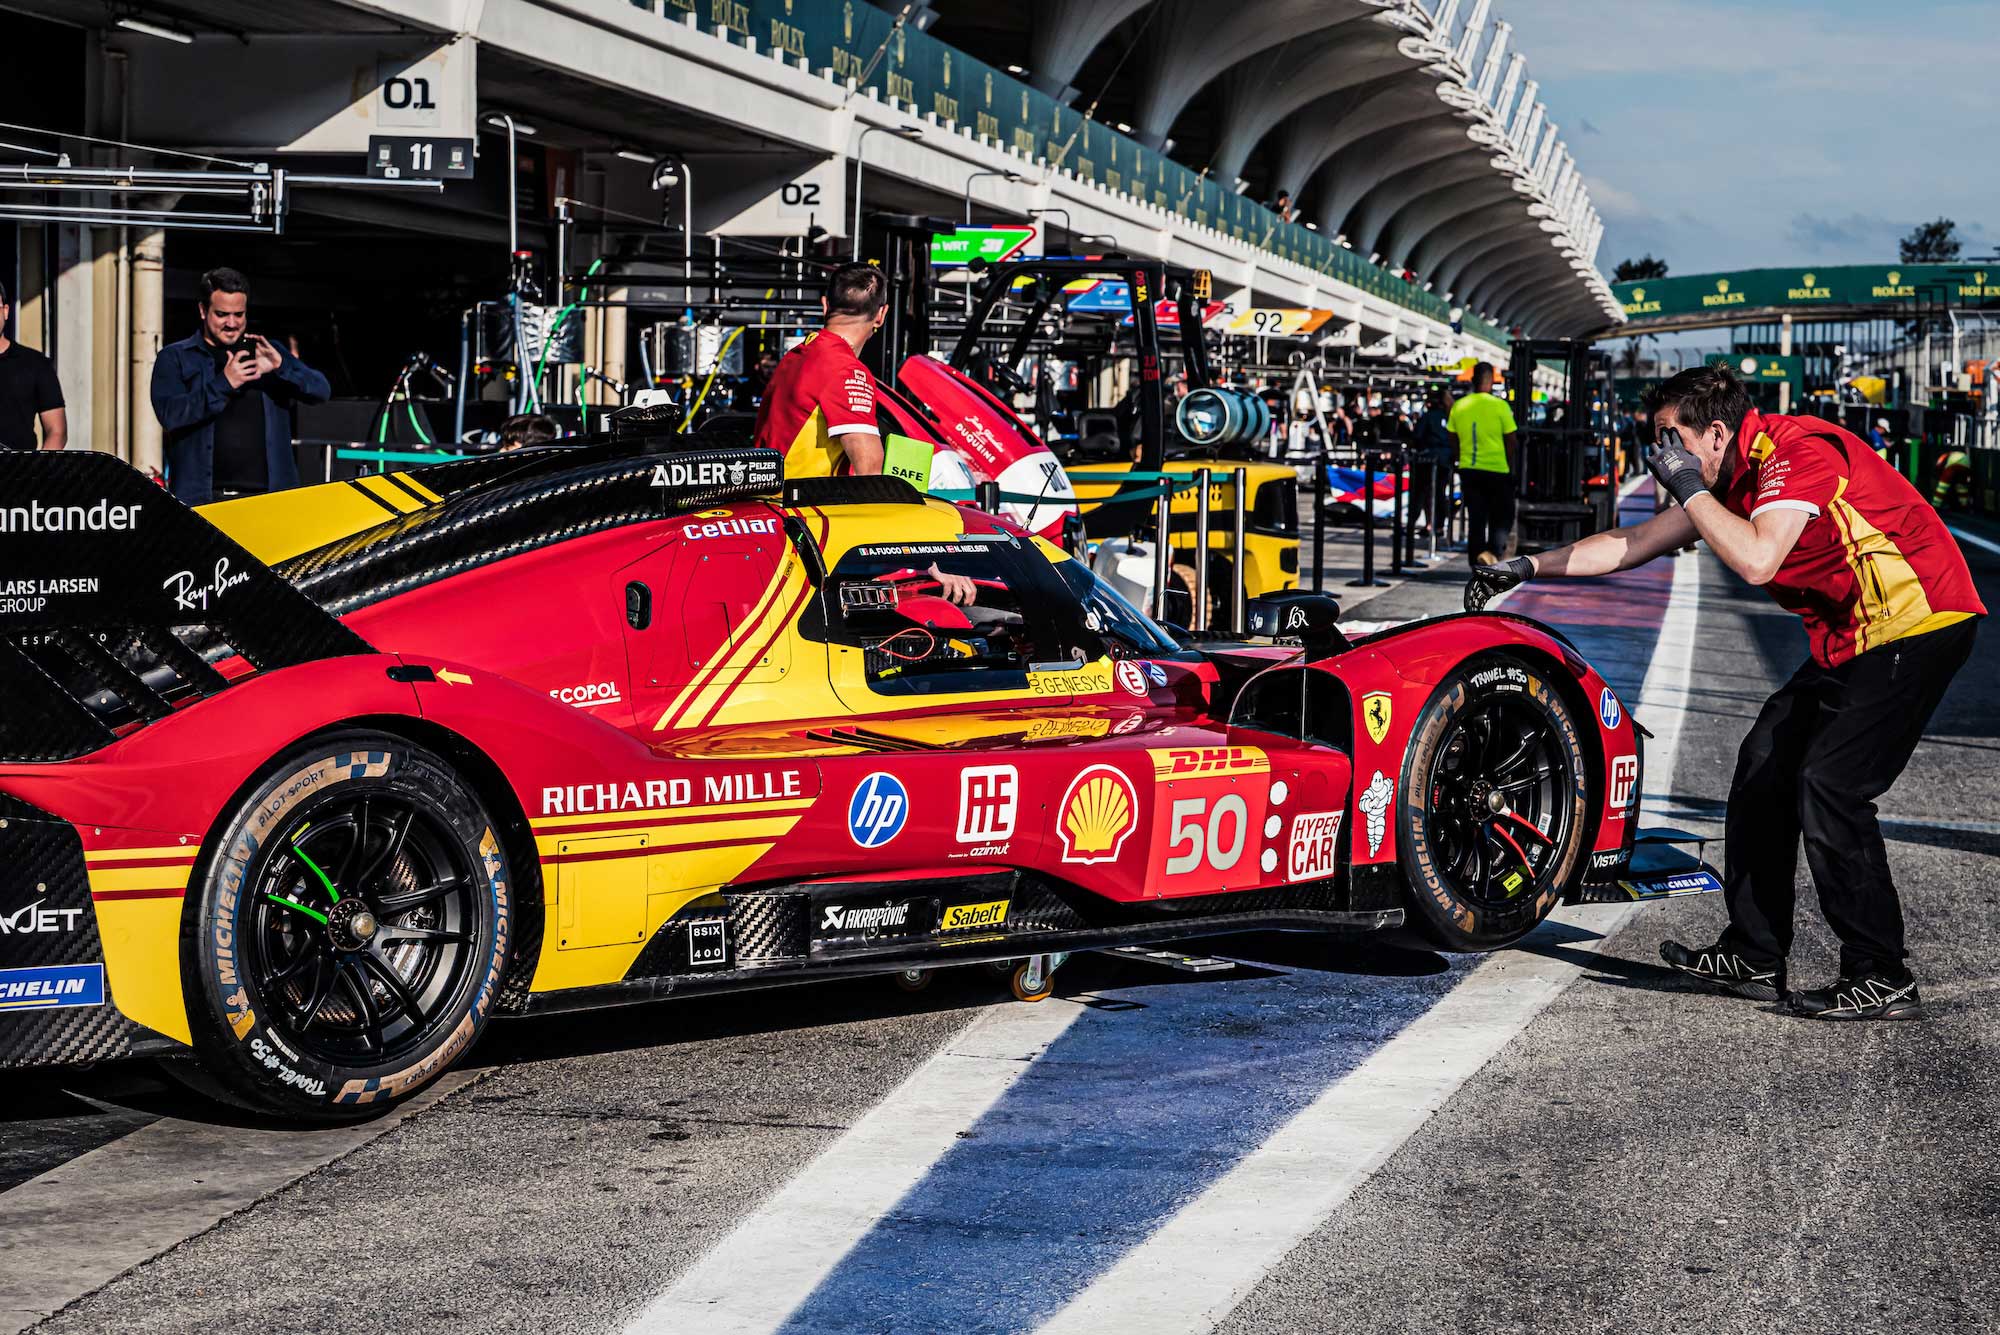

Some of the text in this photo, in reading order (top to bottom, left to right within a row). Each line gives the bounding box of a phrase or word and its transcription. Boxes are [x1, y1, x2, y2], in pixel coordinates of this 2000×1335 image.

[711, 0, 750, 36] ROLEX
[771, 18, 806, 58] ROLEX
[383, 76, 436, 109] 01
[410, 143, 433, 170] 11
[781, 184, 820, 205] 02
[942, 240, 969, 252] WRT
[979, 238, 1005, 253] 31
[1702, 292, 1746, 306] ROLEX
[1787, 286, 1831, 299] ROLEX
[1872, 285, 1915, 298] ROLEX
[1254, 312, 1282, 333] 92
[955, 423, 996, 464] DUQUEINE
[650, 462, 727, 487] ADLER
[748, 472, 777, 483] GROUP
[749, 461, 776, 472] PELZER
[891, 466, 924, 483] SAFE
[0, 578, 99, 596] LARS LARSEN
[0, 597, 46, 614] GROUP
[1043, 674, 1110, 696] GENESYS
[1470, 667, 1506, 688] TRAVEL
[1506, 667, 1528, 684] #50
[1169, 748, 1254, 774] DHL
[259, 768, 326, 828] PILOT SPORT
[542, 769, 801, 815] RICHARD MILLE
[855, 775, 903, 846] hp
[1165, 793, 1248, 876] 50
[1293, 814, 1341, 841] HYPER
[970, 841, 1010, 857] azimut
[1291, 837, 1333, 876] CAR
[1411, 815, 1453, 911] MICHELIN
[1652, 876, 1709, 890] MICHELIN
[216, 843, 252, 985] MICHELIN
[845, 903, 910, 929] AKRAPOVIČ
[948, 904, 1002, 927] Sabelt
[693, 925, 721, 937] 8SIX
[476, 881, 508, 1016] MICHELIN
[250, 1038, 280, 1069] #50
[277, 1064, 327, 1096] TRAVEL
